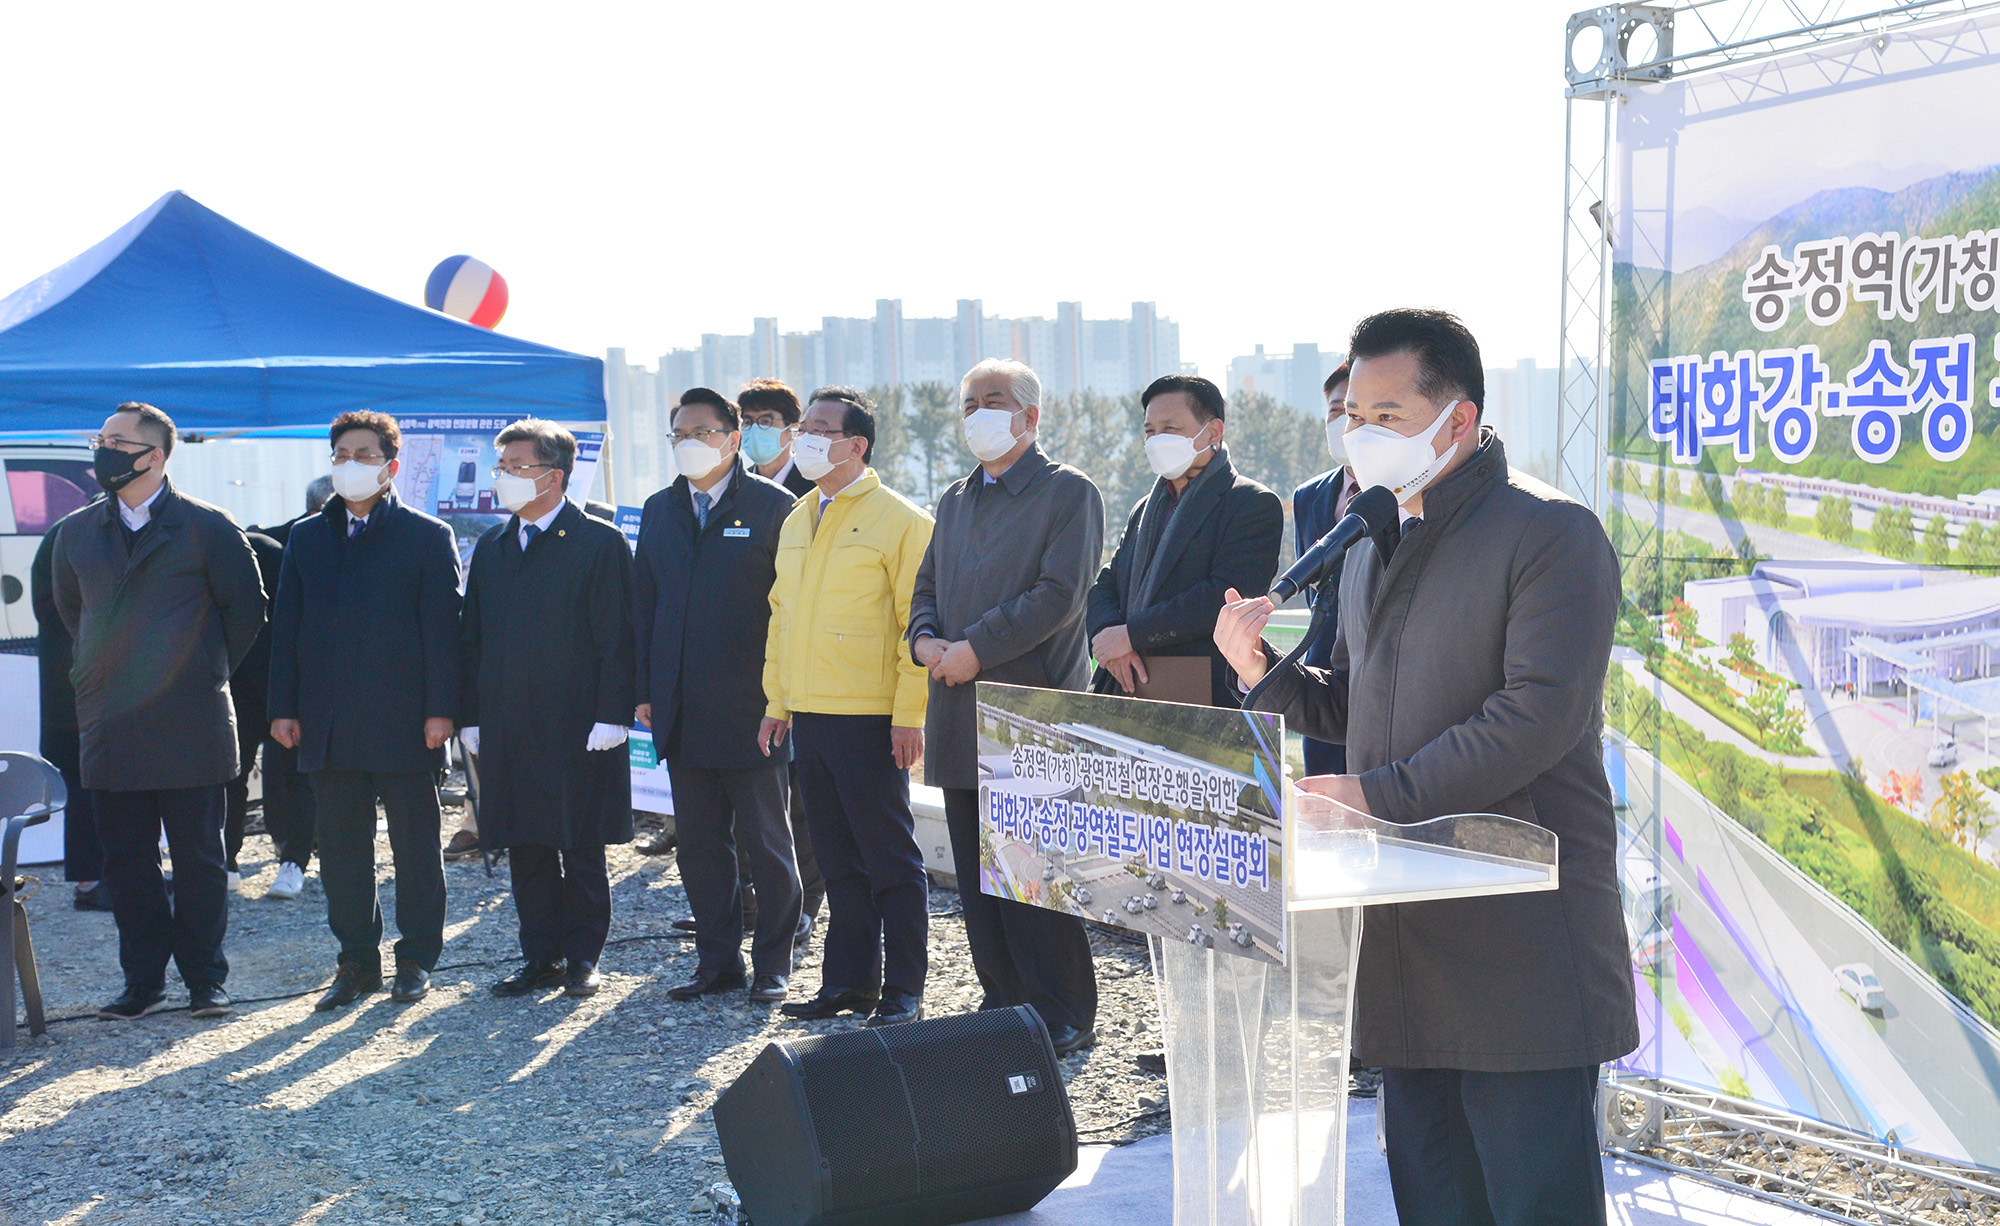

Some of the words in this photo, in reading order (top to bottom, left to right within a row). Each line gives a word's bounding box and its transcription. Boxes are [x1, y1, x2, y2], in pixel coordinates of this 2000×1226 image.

[1747, 237, 1999, 324] 송정역(가칭
[1652, 342, 1970, 457] 태화강·송정
[1012, 745, 1077, 785] 송정역(가칭)
[1080, 755, 1131, 797] 광역전철
[1134, 761, 1202, 810] 연장운행을
[1207, 772, 1238, 814] 위한
[989, 790, 1070, 849] 태화강·송정
[1073, 804, 1171, 869] 광역철도사업
[1176, 820, 1268, 889] 현장설명회
